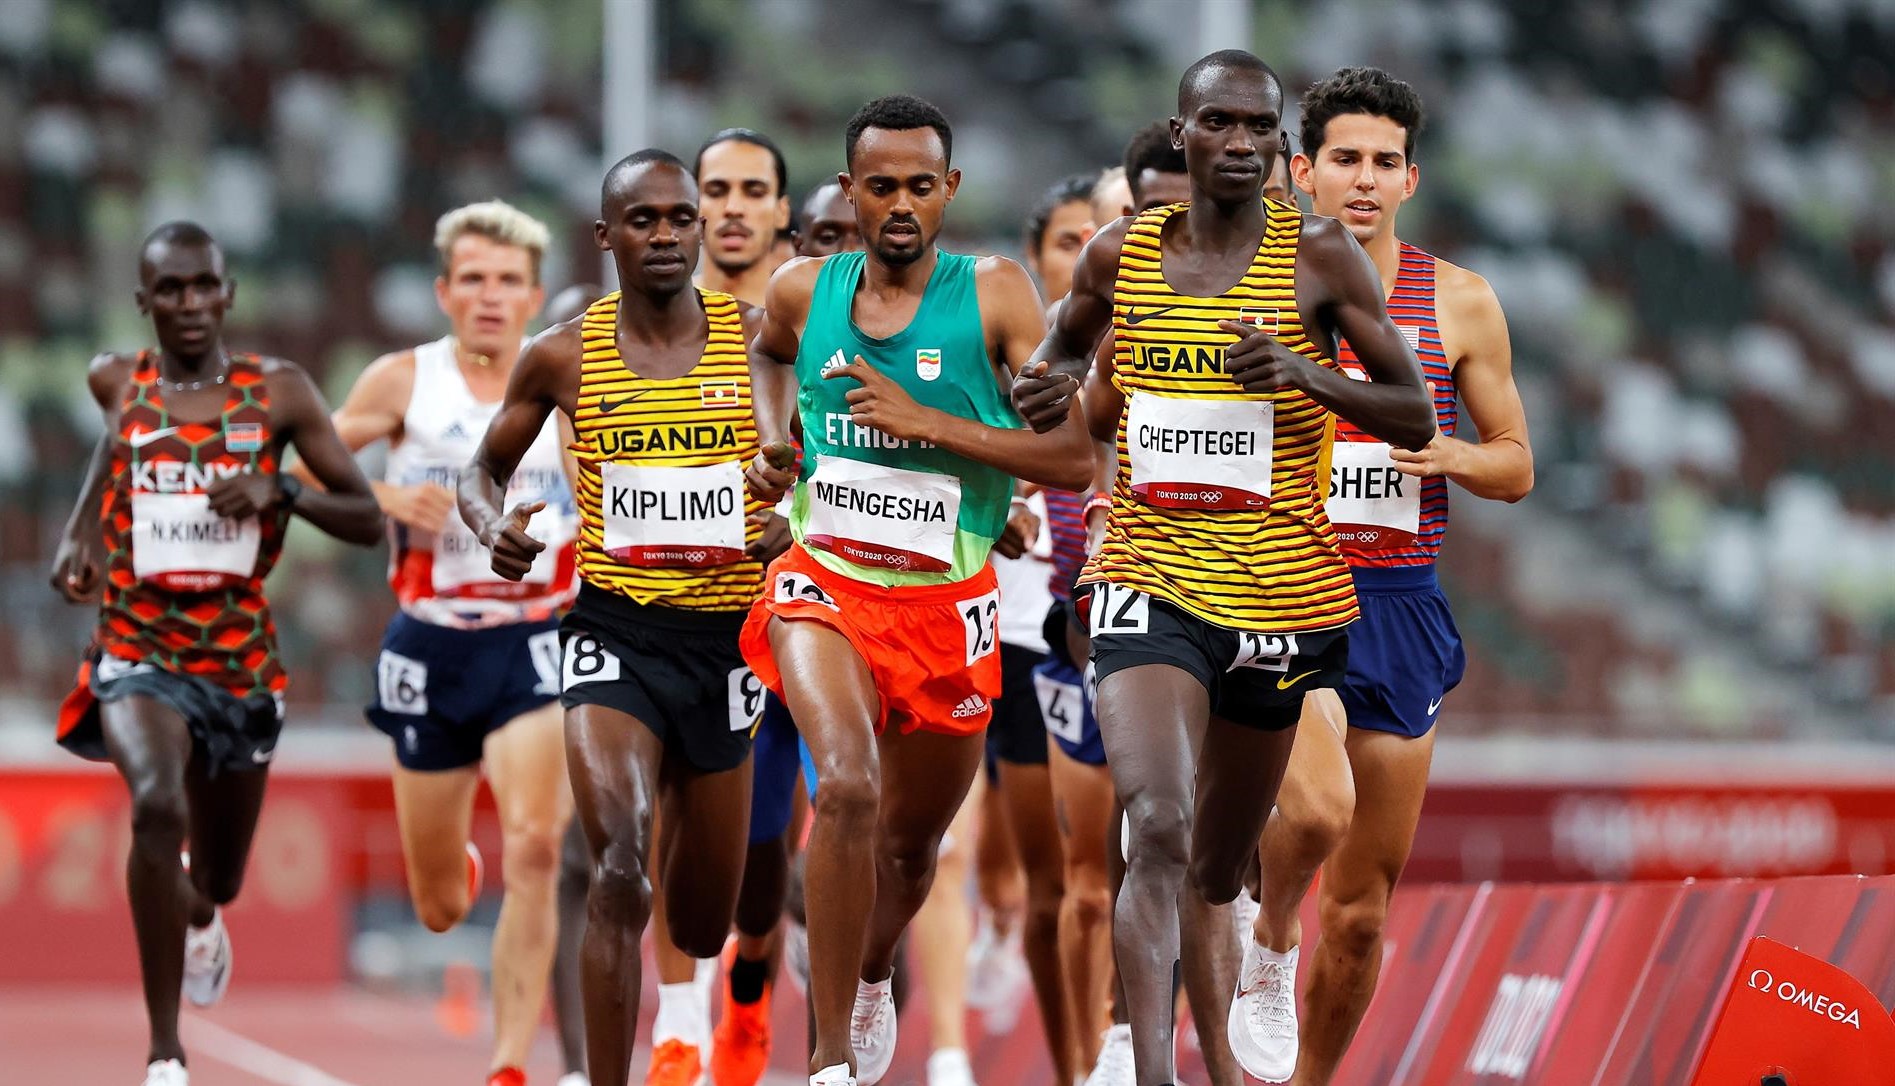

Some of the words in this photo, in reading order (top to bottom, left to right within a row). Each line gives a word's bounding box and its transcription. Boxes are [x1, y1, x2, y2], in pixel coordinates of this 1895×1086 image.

[1131, 345, 1233, 374] UGAN
[598, 425, 737, 455] UGANDA
[1139, 424, 1255, 456] CHEPTEGEI
[612, 486, 734, 521] KIPLIMO
[816, 480, 947, 523] MENGESHA
[1156, 490, 1179, 500] TOKYO
[1179, 492, 1198, 501] 2020
[1337, 532, 1355, 541] 2020
[643, 551, 666, 560] TOKYO
[843, 545, 864, 560] TOKYO
[864, 551, 882, 562] 2020
[1098, 583, 1140, 629] 12
[966, 600, 997, 655] 13
[572, 634, 606, 677] 8
[951, 704, 988, 719] adidas
[1048, 688, 1069, 728] 4
[1777, 981, 1860, 1030] OMEGA
